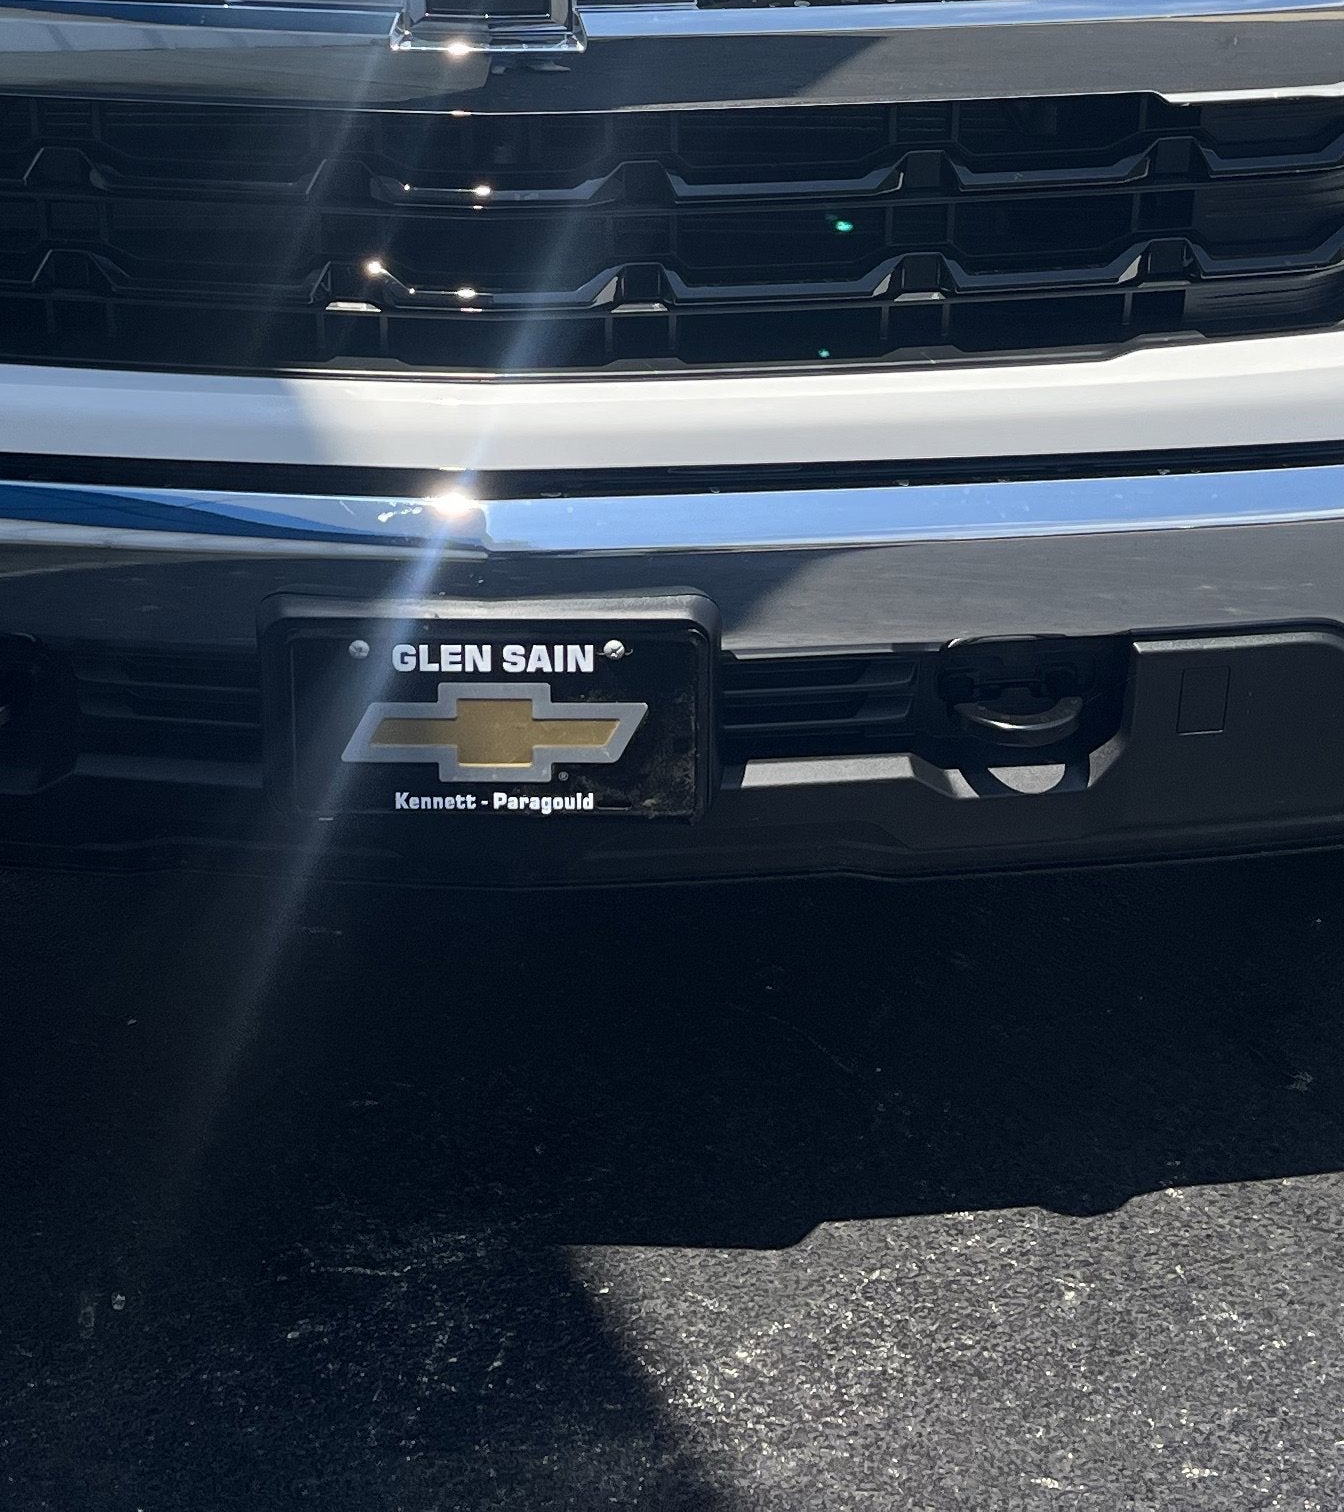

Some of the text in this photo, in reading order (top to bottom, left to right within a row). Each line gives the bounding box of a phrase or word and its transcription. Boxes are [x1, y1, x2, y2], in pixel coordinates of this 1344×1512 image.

[392, 644, 594, 672] GLEN SAIN
[395, 792, 475, 811] Kennett
[493, 792, 594, 815] Paragould
